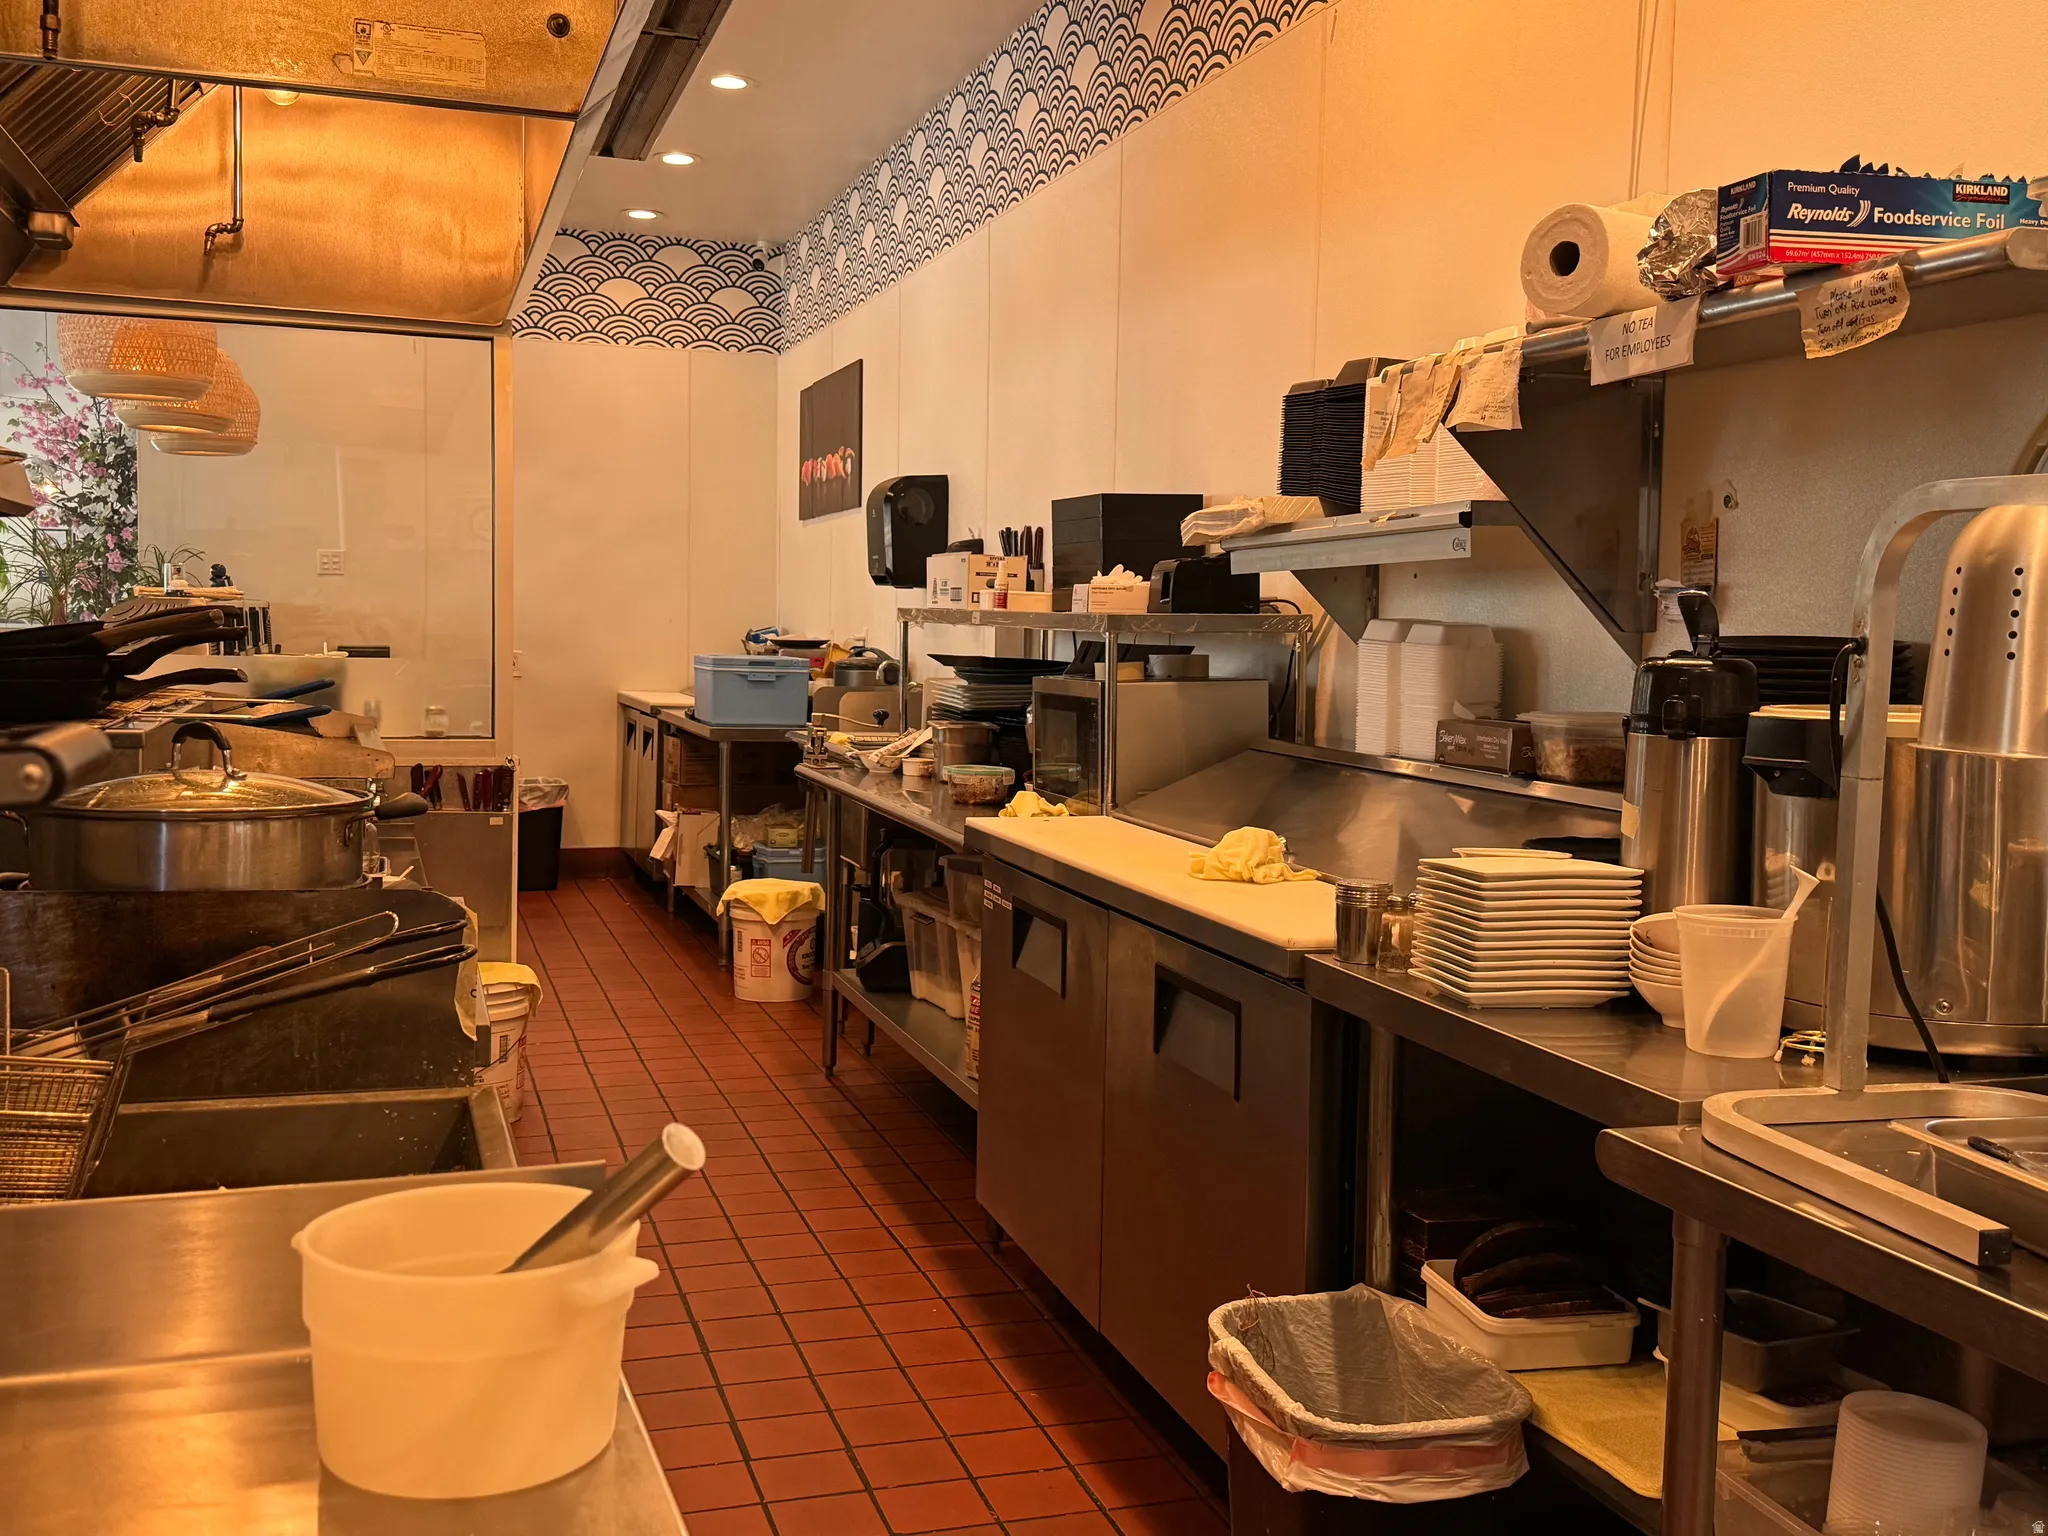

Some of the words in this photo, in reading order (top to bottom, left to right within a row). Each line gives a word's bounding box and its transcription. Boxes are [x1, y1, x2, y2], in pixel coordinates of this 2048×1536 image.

[1730, 181, 1757, 195] KIRKLAND
[1787, 181, 1826, 194] Premium
[1828, 183, 1860, 197] Quality
[1955, 184, 2008, 197] KIRKLAND
[1748, 204, 1757, 213] Foil
[1787, 203, 1854, 224] Reynolds
[1873, 206, 1971, 228] Foodservice
[1976, 212, 2005, 230] Foil
[2019, 218, 2039, 226] Heavy
[1811, 250, 1835, 259] (457mm
[1622, 321, 1636, 336] NO
[1638, 317, 1654, 331] TEA
[1605, 346, 1620, 362] FOR
[1622, 334, 1671, 358] EMPLOYEES
